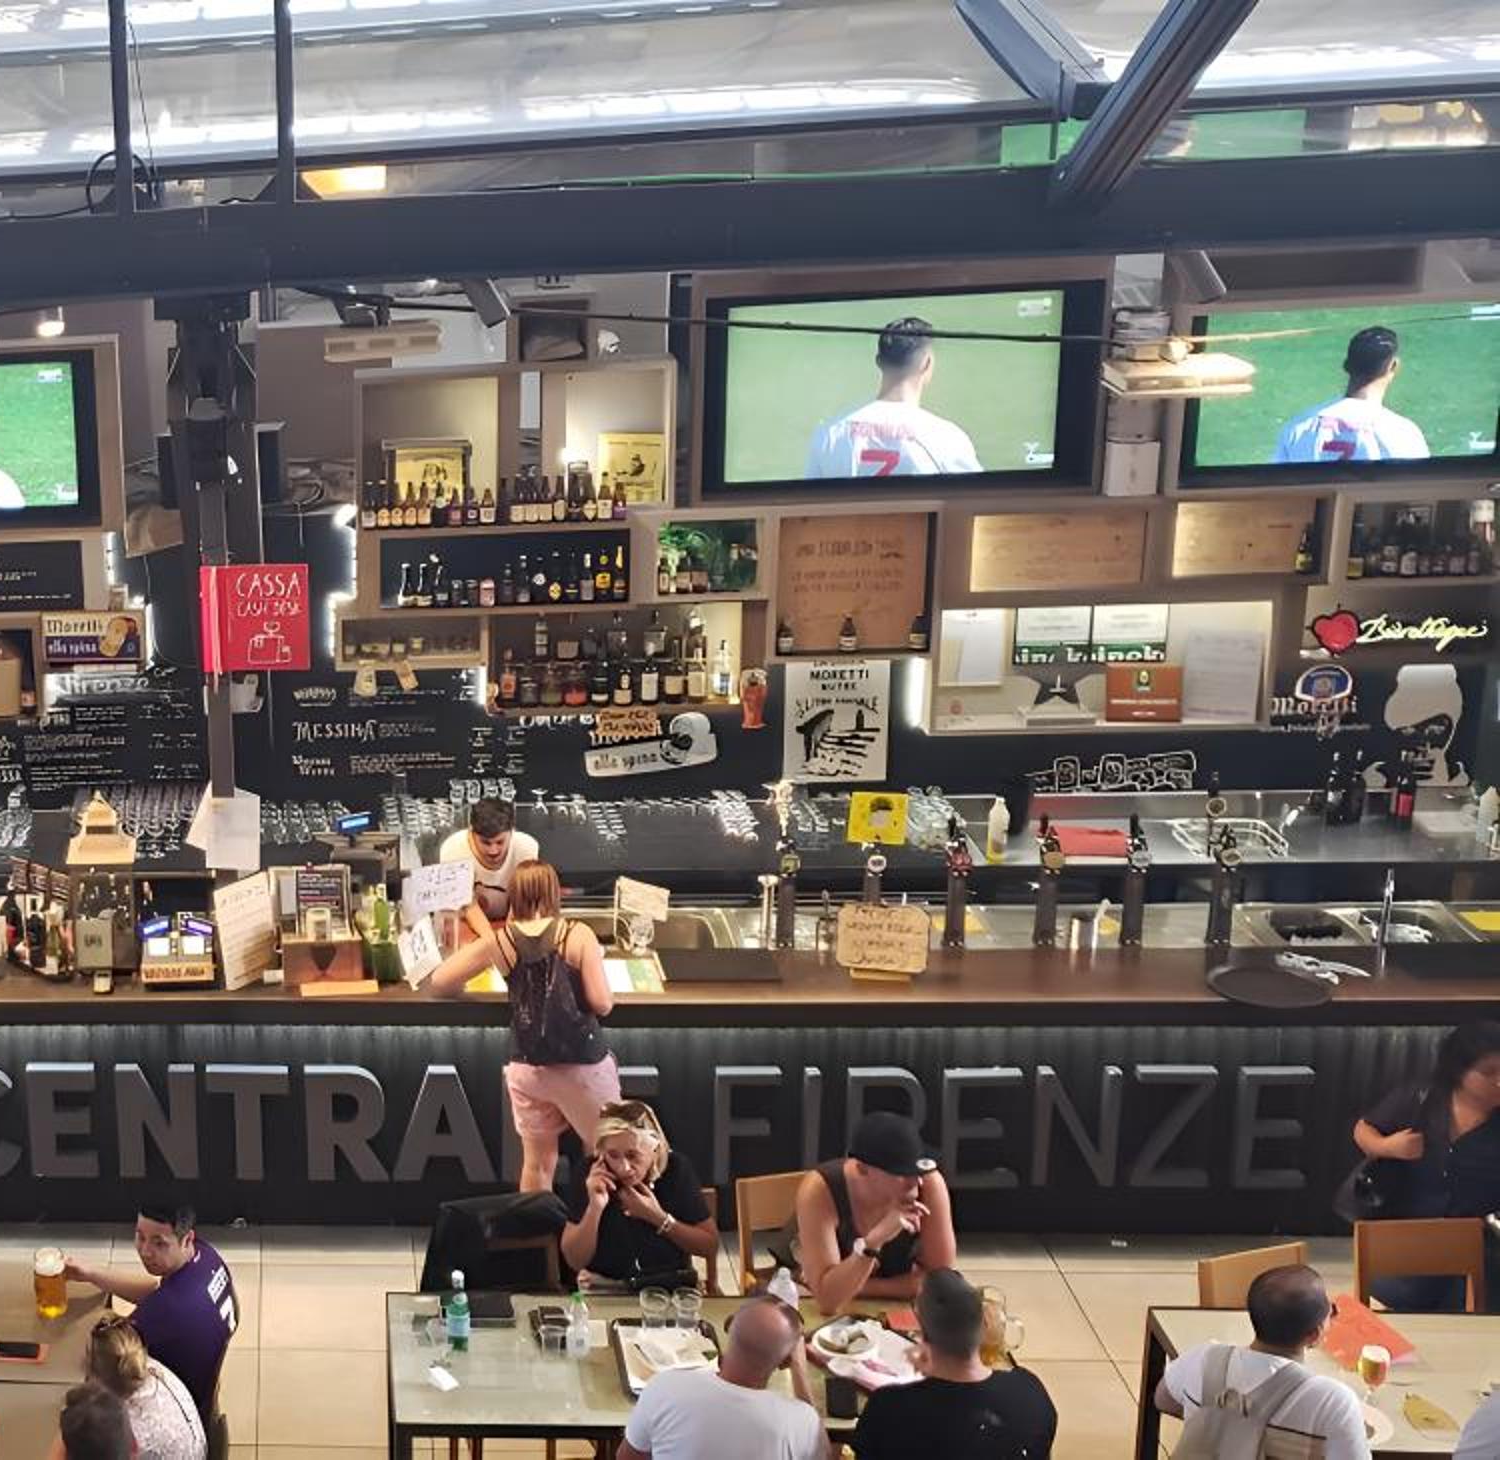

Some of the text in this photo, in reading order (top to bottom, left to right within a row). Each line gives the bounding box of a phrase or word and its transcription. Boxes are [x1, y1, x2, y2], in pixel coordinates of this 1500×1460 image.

[861, 449, 900, 476] 7
[236, 571, 301, 599] CASSA
[809, 669, 869, 681] MORETTI
[711, 1064, 1316, 1190] FIRENZE
